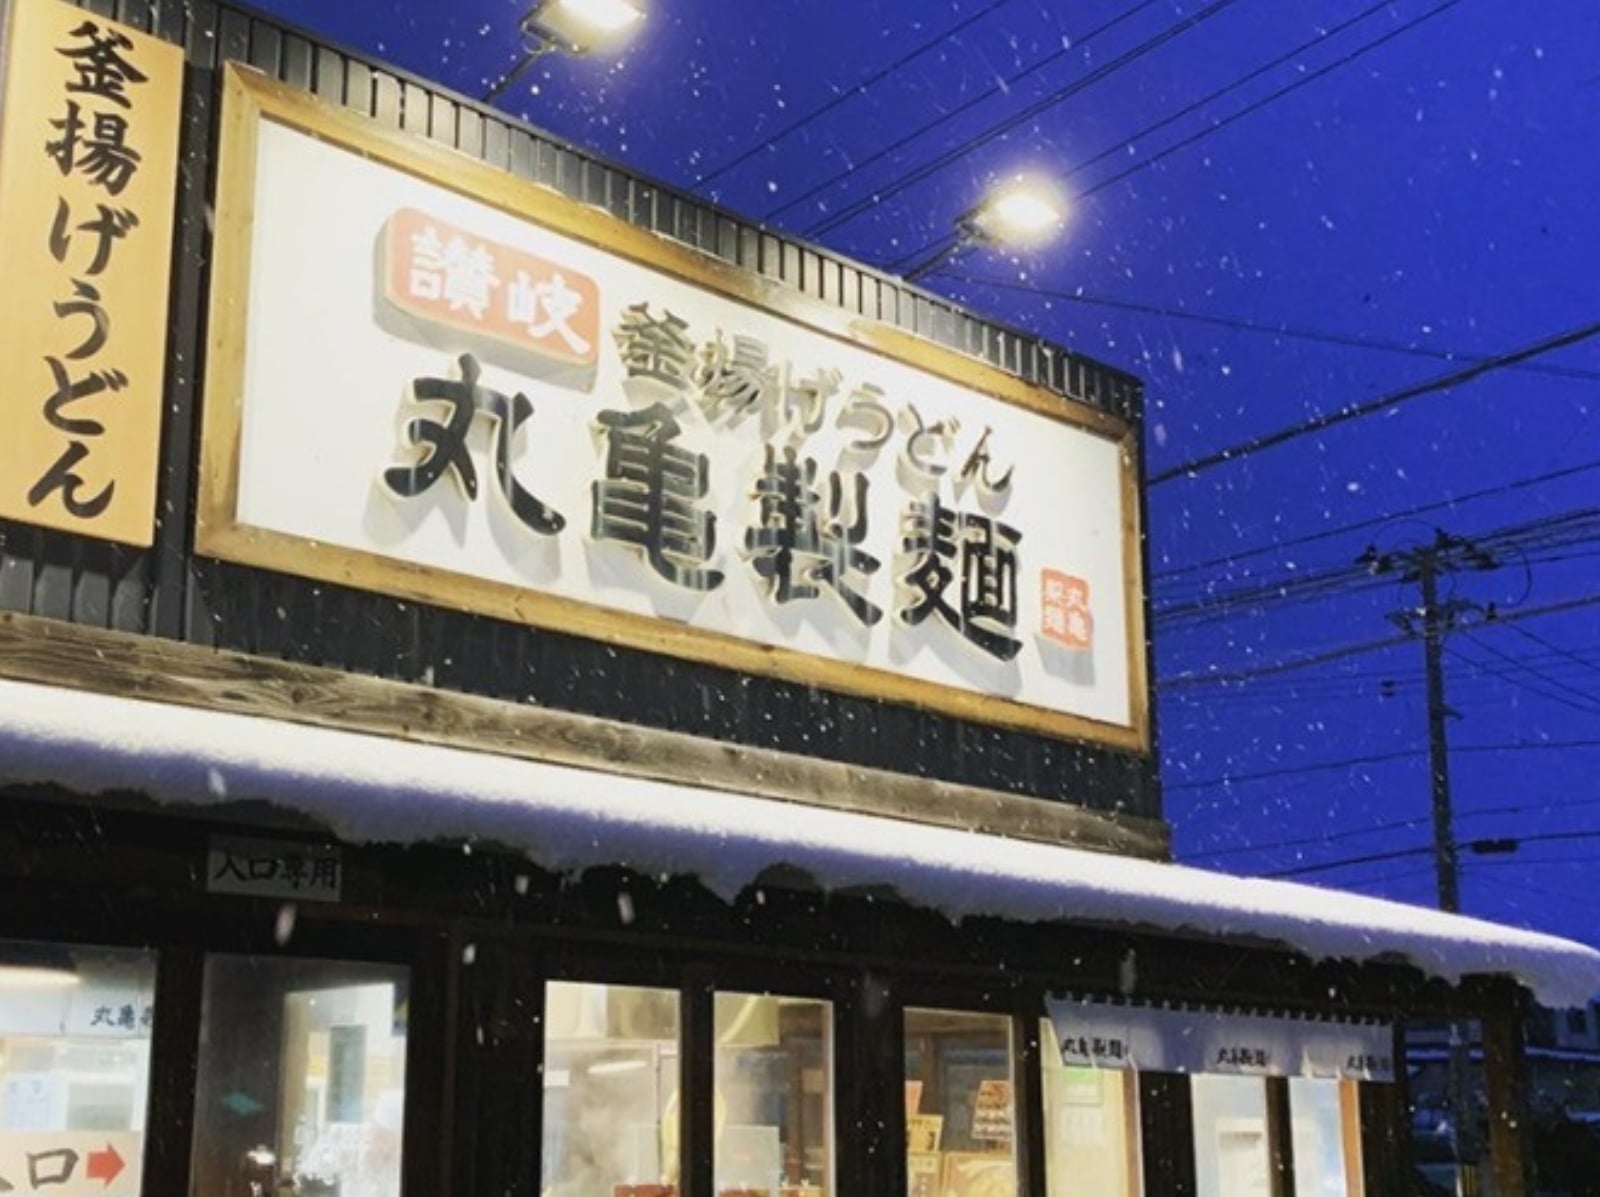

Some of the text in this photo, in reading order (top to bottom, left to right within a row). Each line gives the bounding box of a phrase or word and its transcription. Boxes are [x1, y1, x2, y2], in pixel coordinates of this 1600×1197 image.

[27, 20, 149, 520] 釜揚げうどん
[409, 225, 592, 355] 讃岐
[612, 301, 1015, 493] 釜揚げうどん
[383, 353, 1024, 663] 丸亀製麺
[214, 847, 337, 891] 入口専用
[0, 1147, 80, 1191] 口
